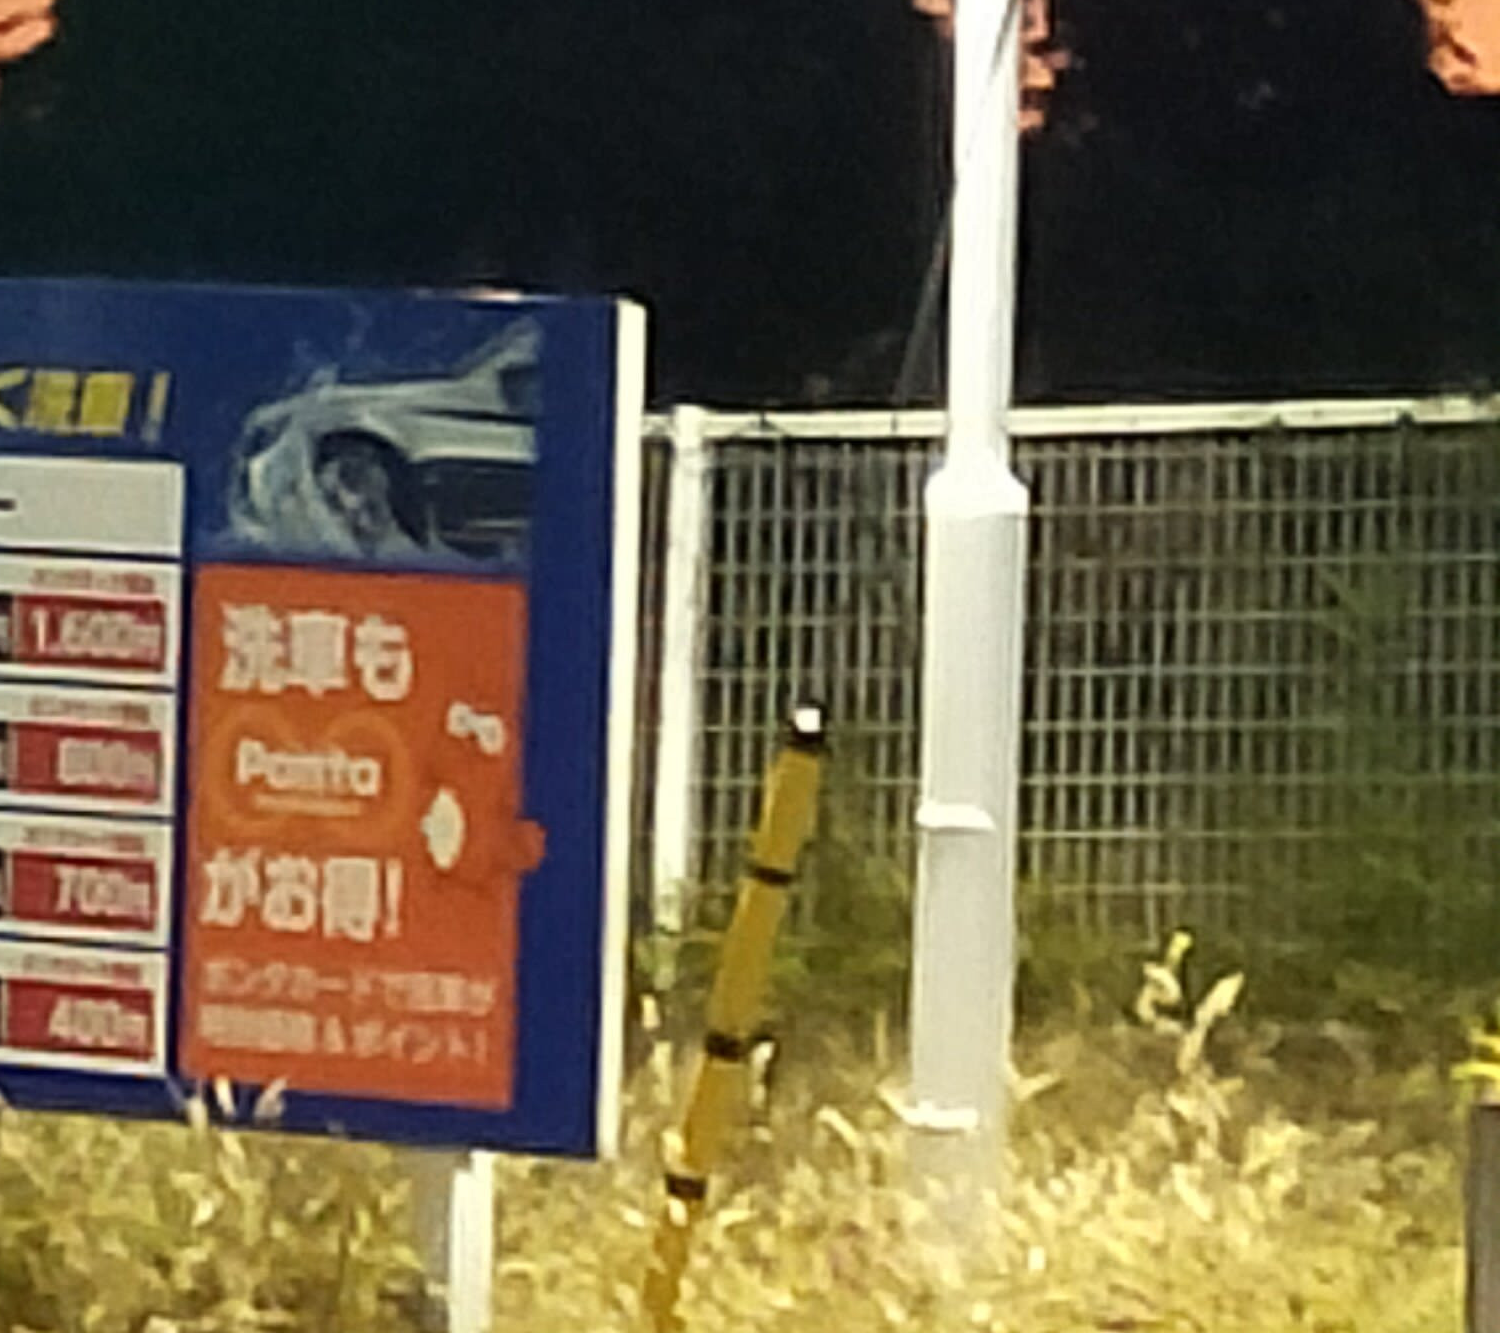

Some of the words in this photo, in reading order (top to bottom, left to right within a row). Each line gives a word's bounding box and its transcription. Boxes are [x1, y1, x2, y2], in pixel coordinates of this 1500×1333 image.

[219, 600, 414, 703] 洗車も
[234, 738, 382, 797] Ponta
[199, 845, 403, 943] がお得!
